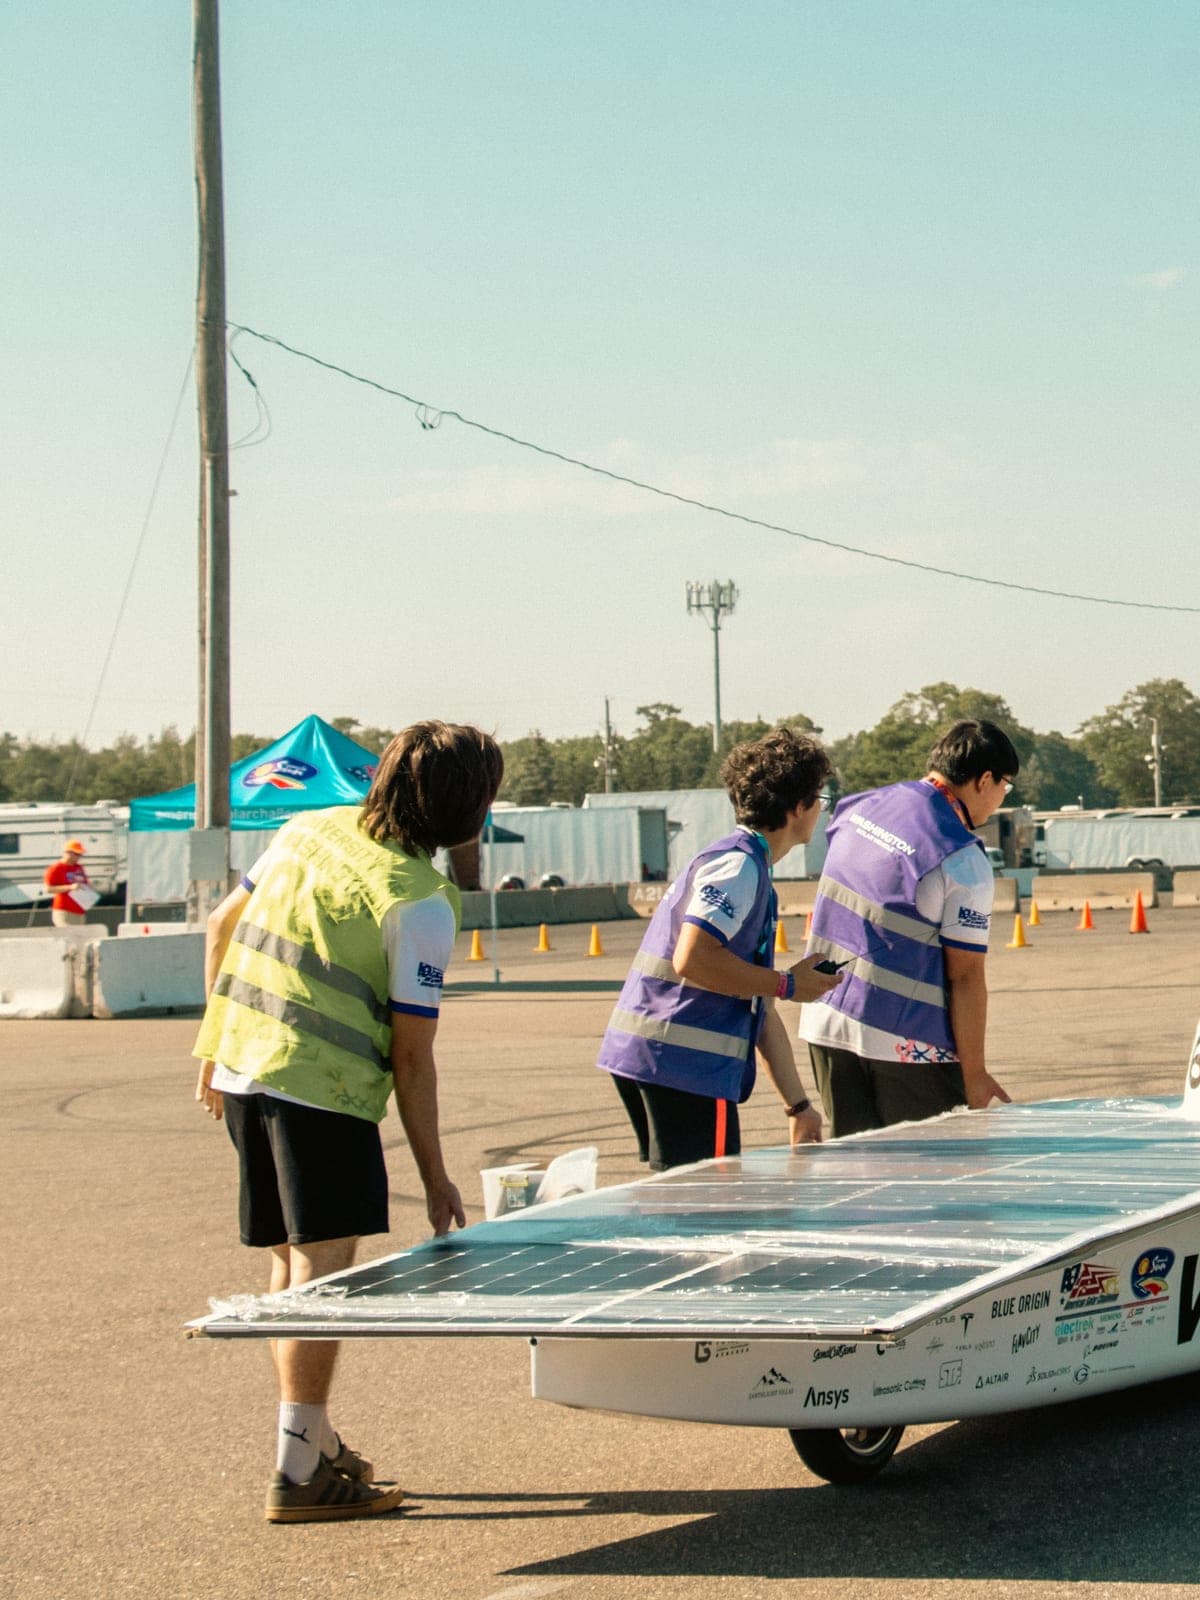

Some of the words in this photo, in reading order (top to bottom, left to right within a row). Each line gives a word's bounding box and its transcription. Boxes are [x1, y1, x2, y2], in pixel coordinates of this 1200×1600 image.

[991, 1297, 1017, 1319] BLUE
[1018, 1290, 1052, 1313] ORIGIN
[985, 1372, 1010, 1385] ALTAIR
[803, 1386, 850, 1410] Ansys
